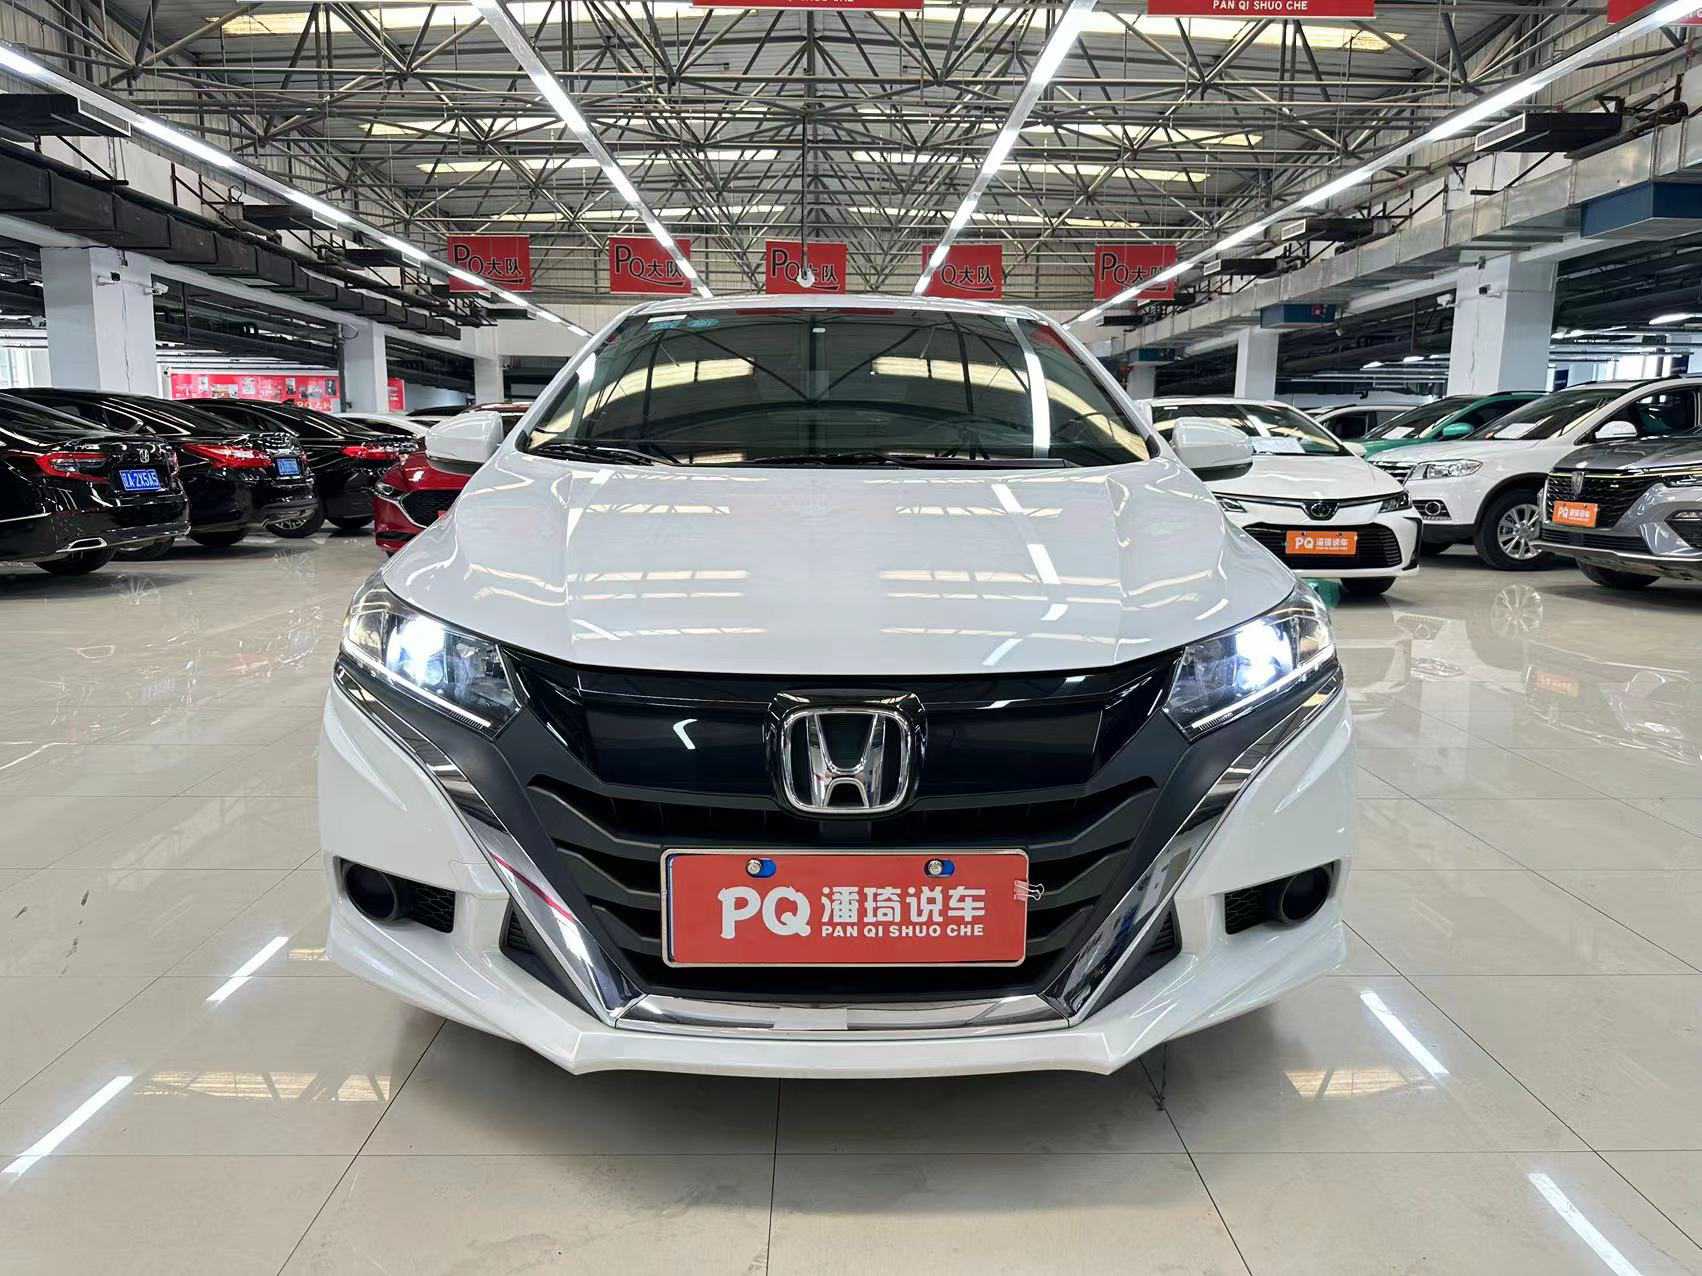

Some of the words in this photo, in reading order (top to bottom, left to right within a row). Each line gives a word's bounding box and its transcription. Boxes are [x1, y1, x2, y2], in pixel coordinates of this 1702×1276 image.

[1212, 0, 1235, 9] PAN
[1238, 0, 1250, 11] QI
[1253, 0, 1283, 10] SHUO
[1286, 0, 1309, 10] CHE
[1295, 537, 1314, 549] PQ
[718, 886, 811, 939] PQ
[821, 886, 986, 923] 潘琦说车
[821, 925, 858, 937] PAN
[863, 925, 883, 938] QI
[889, 925, 941, 937] SHUO
[946, 925, 985, 936] CHE
